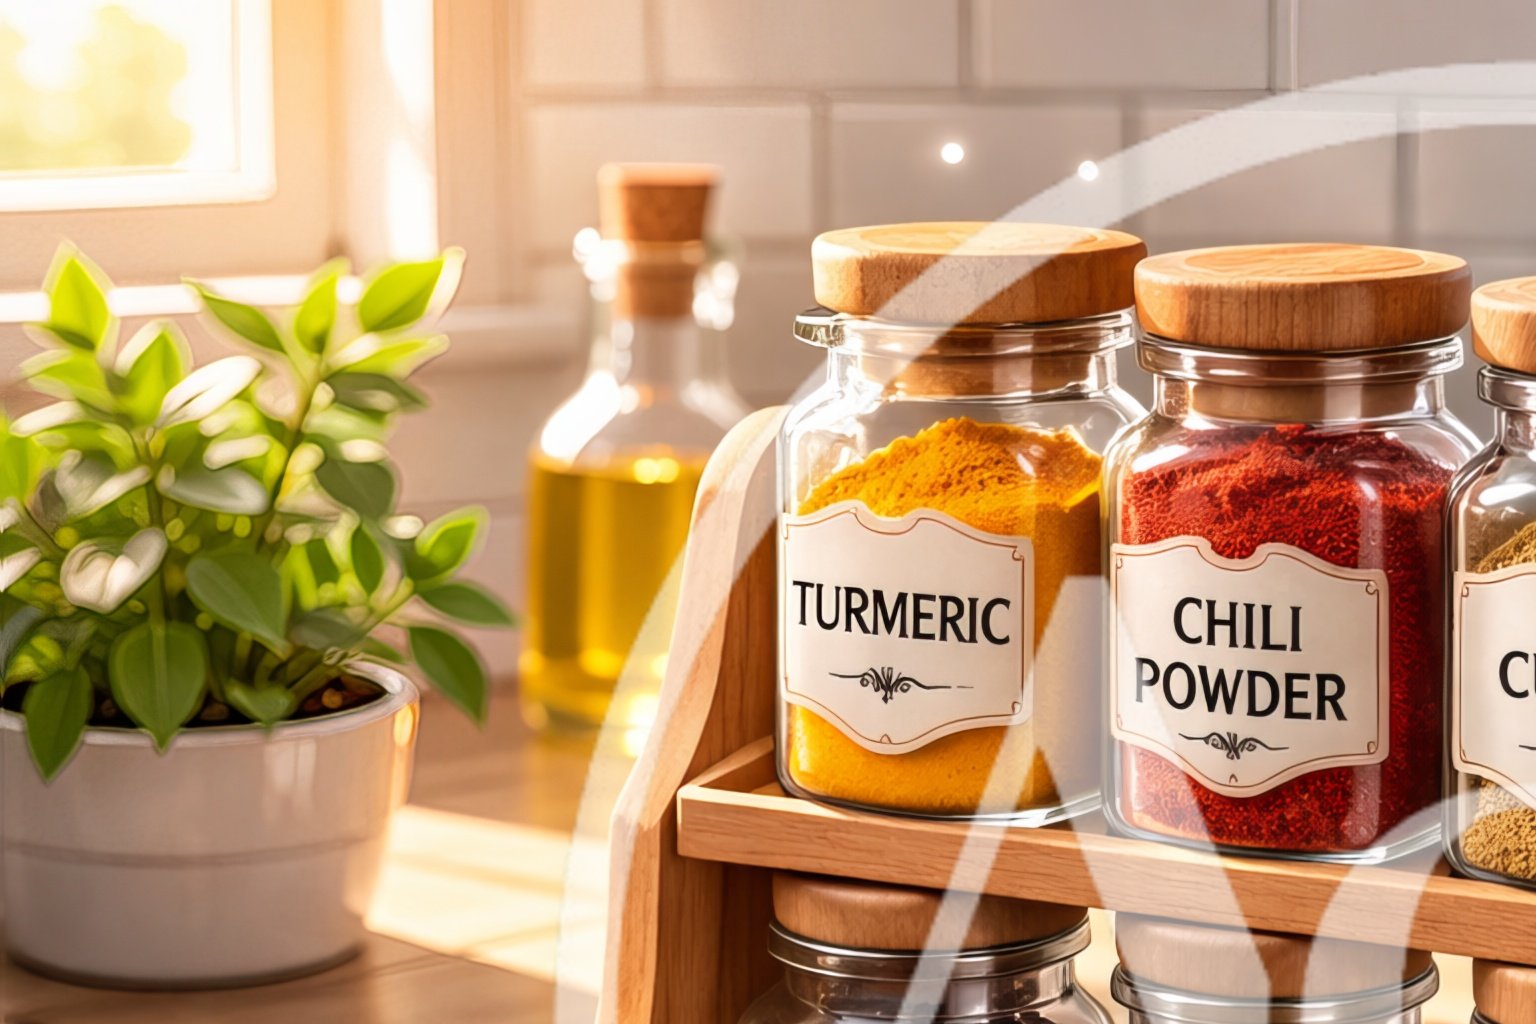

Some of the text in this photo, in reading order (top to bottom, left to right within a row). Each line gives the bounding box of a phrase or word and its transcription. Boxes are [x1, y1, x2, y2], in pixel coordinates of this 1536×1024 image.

[793, 580, 1011, 646] TURMERIC
[1173, 597, 1302, 652] CHILI
[1135, 657, 1347, 721] POWDER
